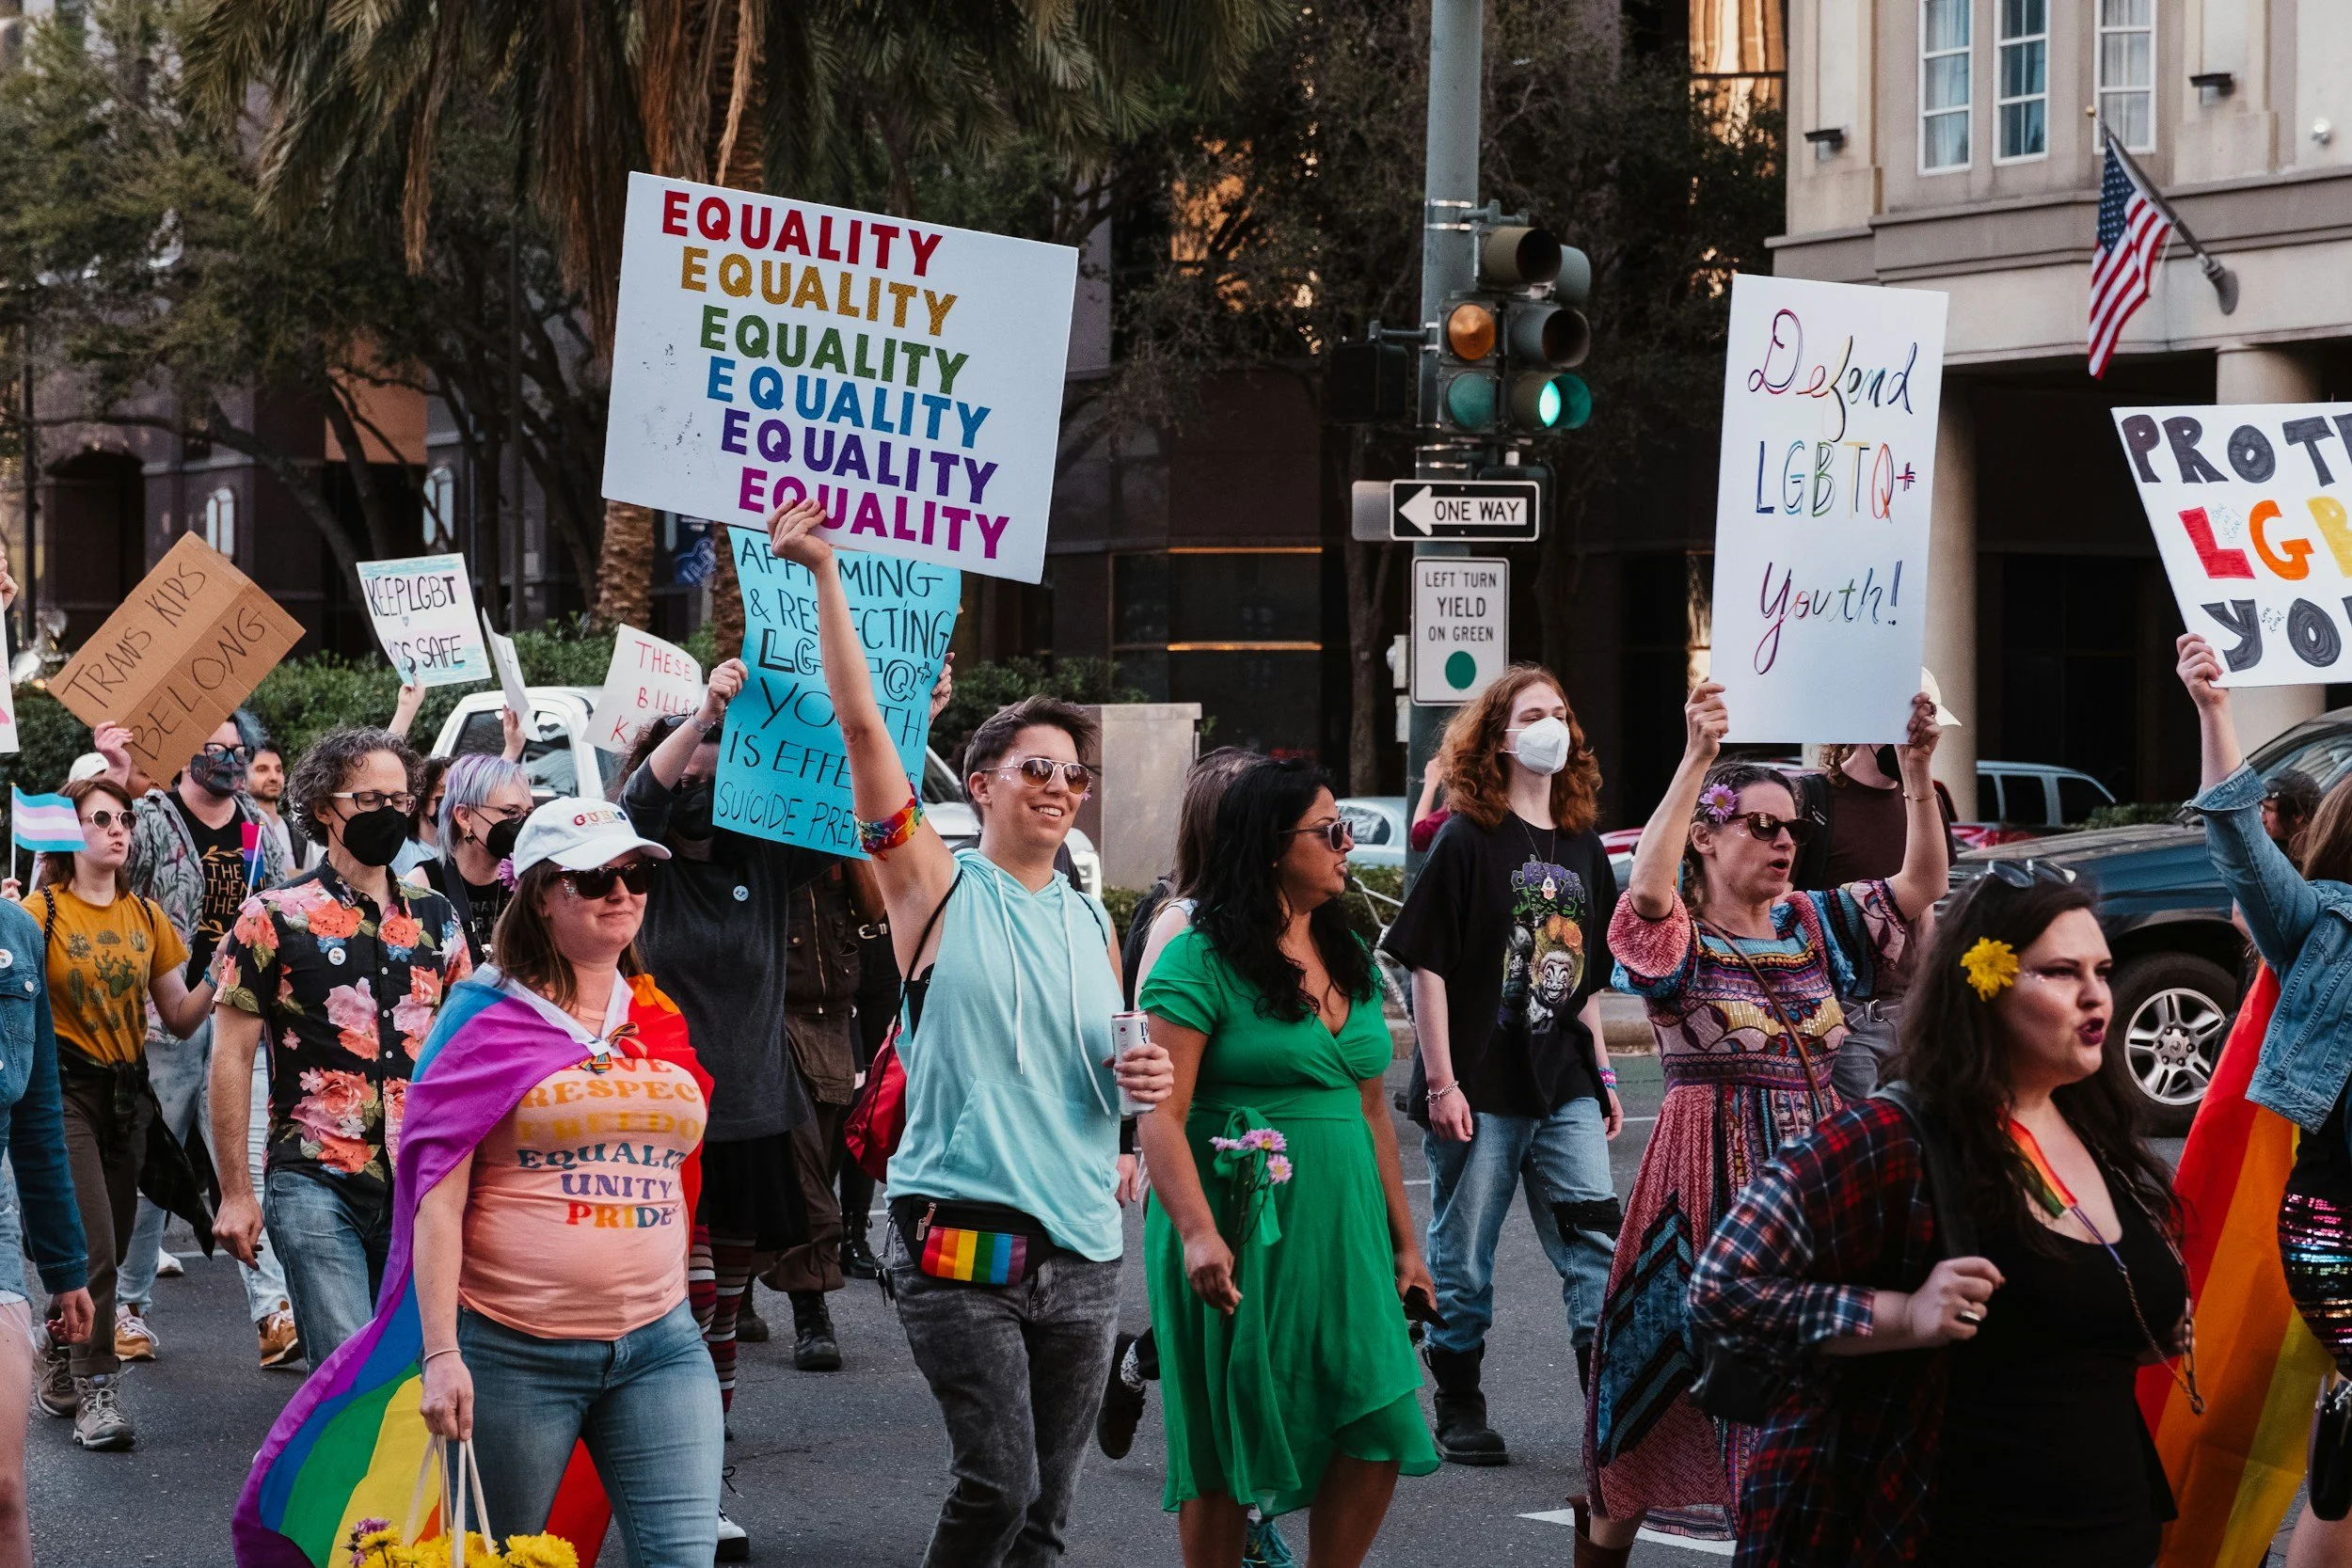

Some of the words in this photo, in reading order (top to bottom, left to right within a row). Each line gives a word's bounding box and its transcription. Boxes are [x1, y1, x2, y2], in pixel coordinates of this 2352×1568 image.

[661, 189, 943, 277] EQUALITY
[680, 245, 958, 336] EQUALITY
[700, 304, 970, 395] EQUALITY
[1748, 309, 1916, 442] Defend
[707, 356, 991, 449] EQUALITY
[721, 407, 998, 504] EQUALITY
[1756, 440, 1915, 523] LGBTQ+
[2121, 413, 2352, 487] PROT
[739, 467, 1009, 560] EQUALITY
[1435, 500, 1471, 521] ONE
[1479, 500, 1519, 521] WAY
[740, 537, 944, 597] AFFIMING
[1424, 571, 1455, 588] LEFT
[1464, 572, 1497, 588] TURN
[61, 626, 151, 709] TRANS
[144, 562, 206, 627] KIDS
[750, 588, 771, 623] &
[777, 588, 951, 659] RESCTING
[1428, 626, 1446, 641] ON
[1453, 626, 1494, 641] GREEN
[1437, 596, 1486, 618] YIELD
[1754, 560, 1902, 675] Youth!
[2200, 594, 2352, 673] YO
[129, 607, 265, 761] BELONG
[417, 635, 466, 669] SAFE
[635, 640, 692, 682] THESE
[757, 627, 932, 703] LGQ+
[637, 687, 691, 716] BILLS
[760, 676, 923, 747] YOTH
[208, 863, 245, 880] THE
[519, 1079, 699, 1108] RESPEC
[517, 1142, 687, 1170] EQUALIT
[561, 1173, 673, 1200] UNITY
[565, 1202, 675, 1228] PRIDE
